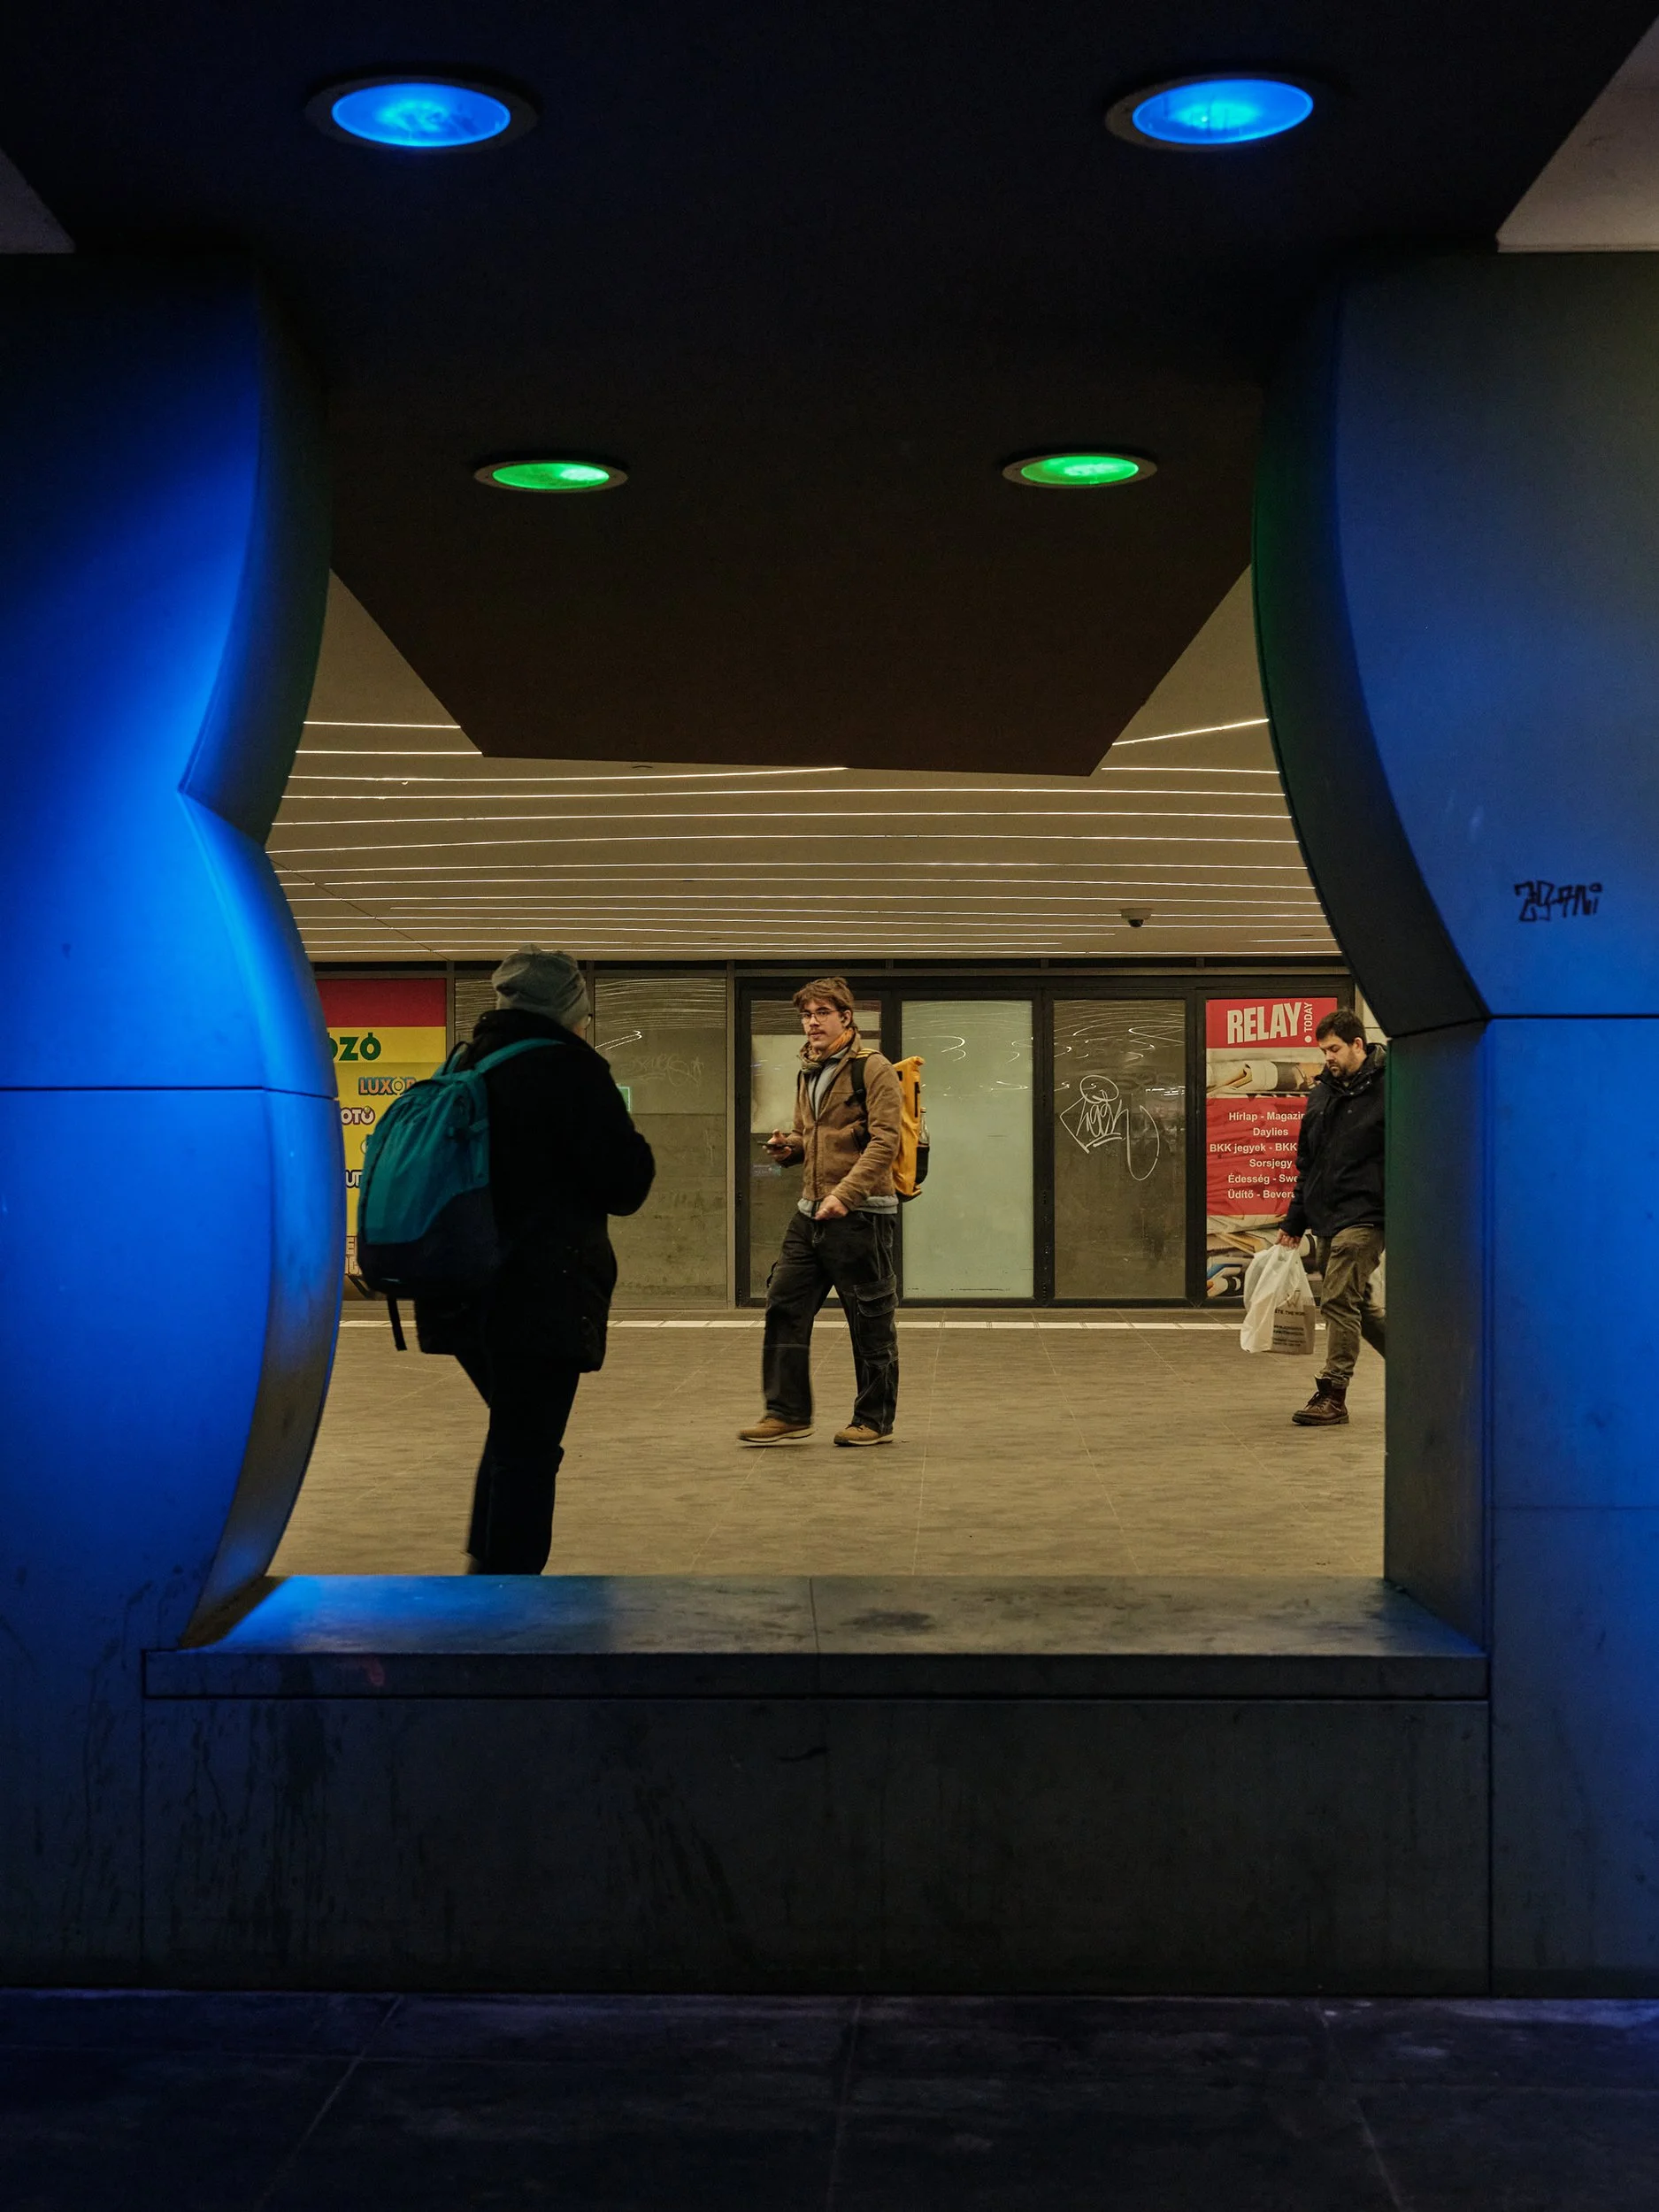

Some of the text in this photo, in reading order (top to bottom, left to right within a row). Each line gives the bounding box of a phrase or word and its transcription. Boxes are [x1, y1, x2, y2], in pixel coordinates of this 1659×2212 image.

[1227, 1002, 1302, 1044] RELAY
[1303, 1002, 1313, 1033] TODAY
[1228, 1112, 1258, 1123] Hírlap
[1253, 1127, 1289, 1138] Daylies
[1210, 1144, 1232, 1153] BKK
[1233, 1143, 1266, 1154] jegyek
[1275, 1143, 1297, 1152] BKK
[1249, 1158, 1293, 1169] Sorsjegy
[1227, 1172, 1270, 1185] Édesség
[1227, 1188, 1254, 1199] Üdítő
